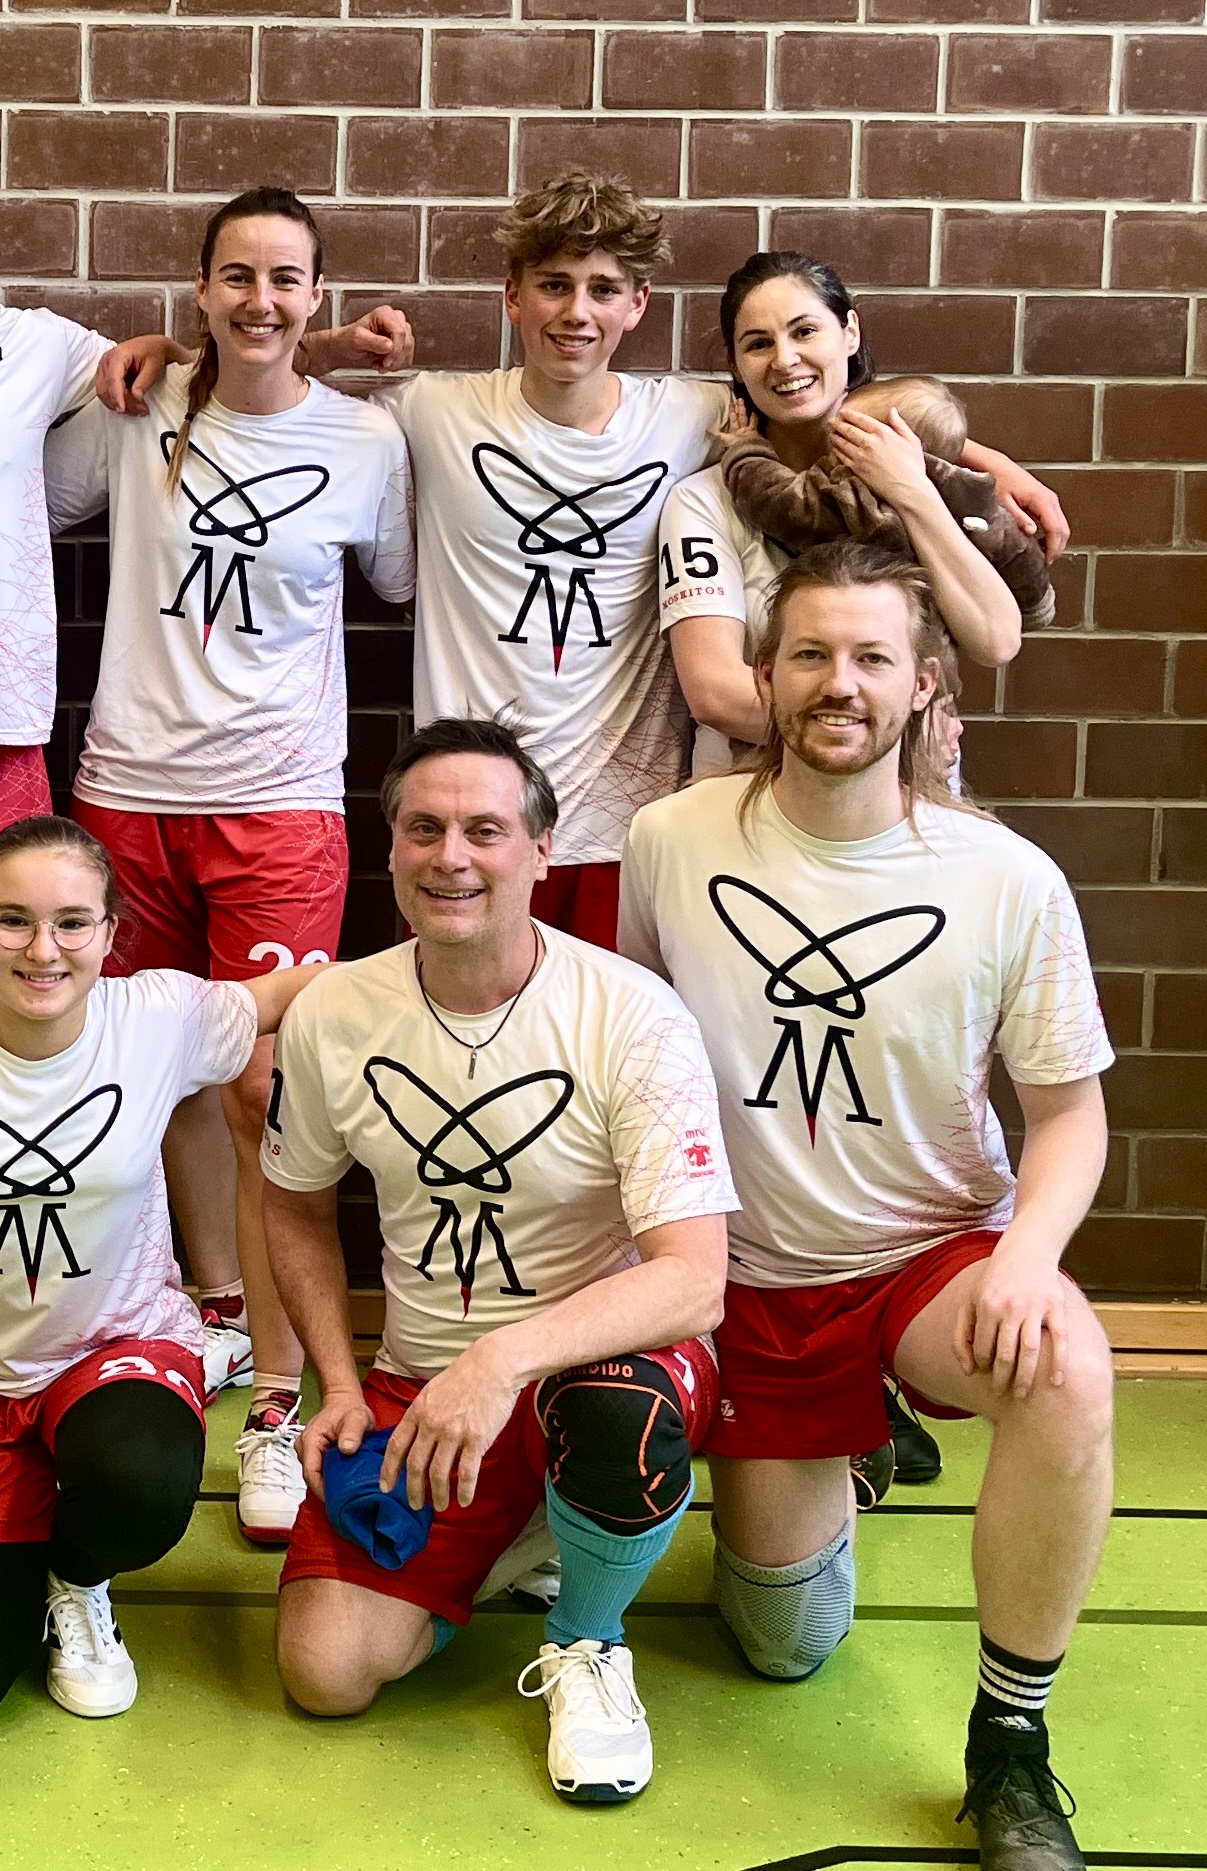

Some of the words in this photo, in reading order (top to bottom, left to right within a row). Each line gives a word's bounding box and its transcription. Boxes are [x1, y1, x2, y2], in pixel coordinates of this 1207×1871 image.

[660, 536, 719, 590] 15
[662, 586, 725, 610] MOSKITOS
[247, 941, 330, 974] 2
